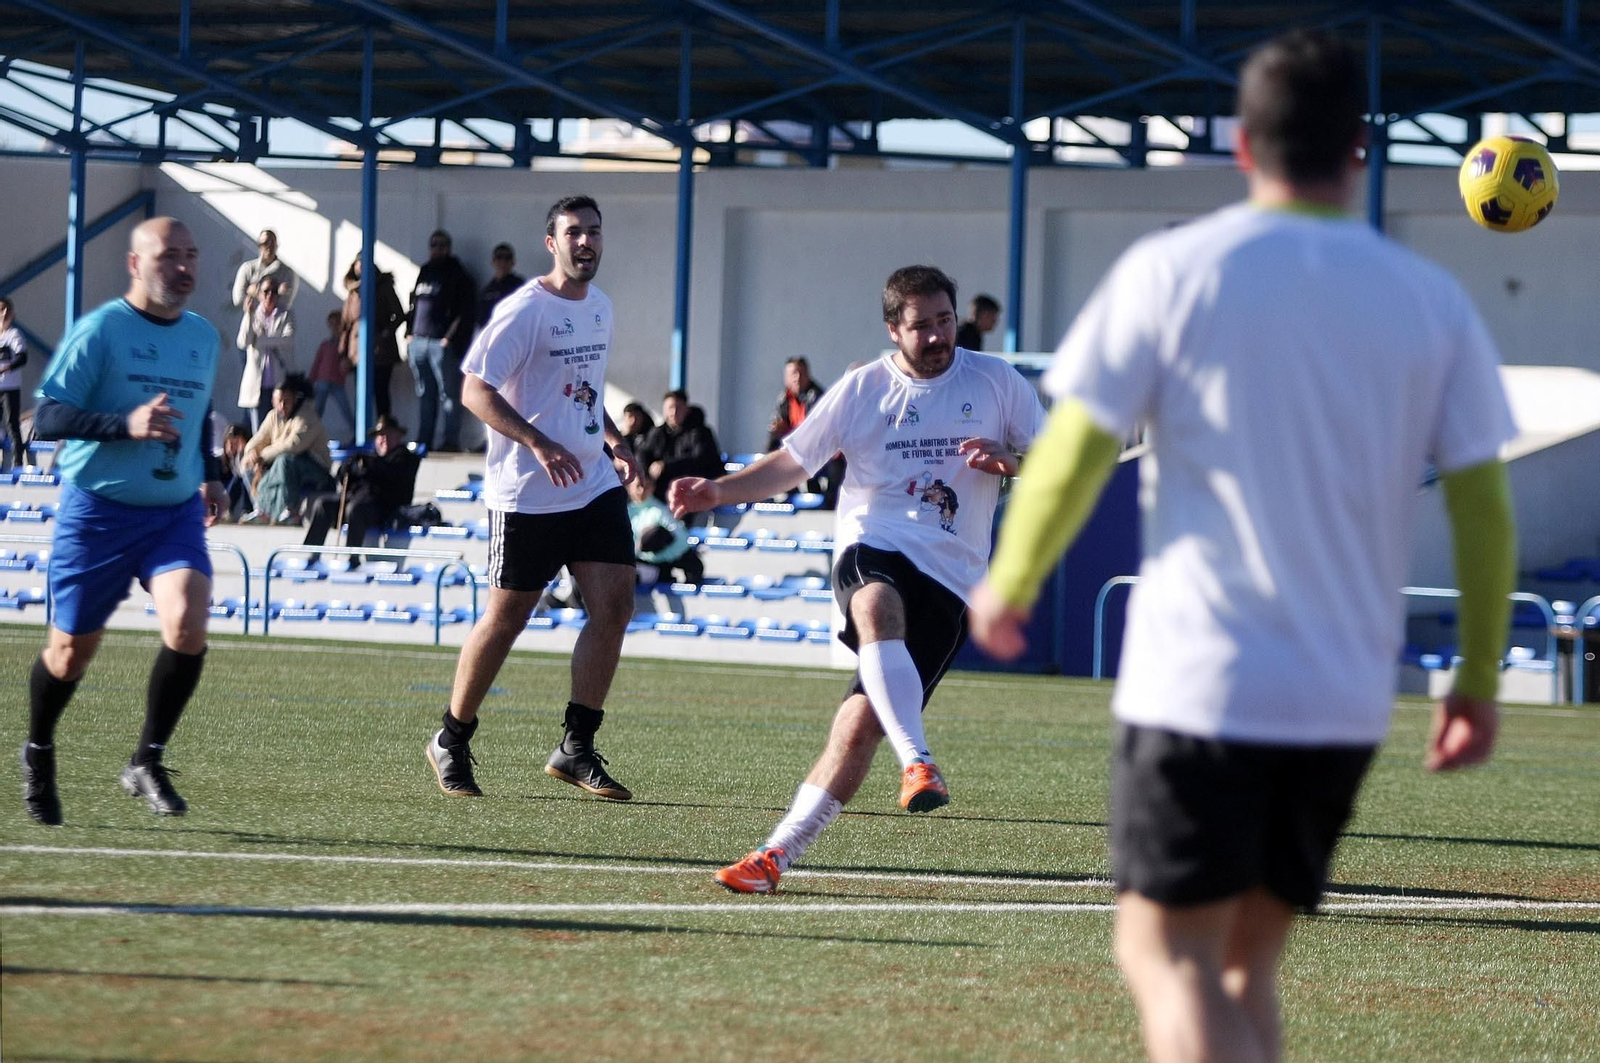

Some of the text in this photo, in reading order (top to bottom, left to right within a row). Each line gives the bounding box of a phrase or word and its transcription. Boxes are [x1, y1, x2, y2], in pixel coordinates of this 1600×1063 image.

[885, 439, 918, 451] HOMENAJE
[920, 437, 948, 447] ÁRBITROS
[902, 447, 968, 459] DE FÚTBOL DE HUELA
